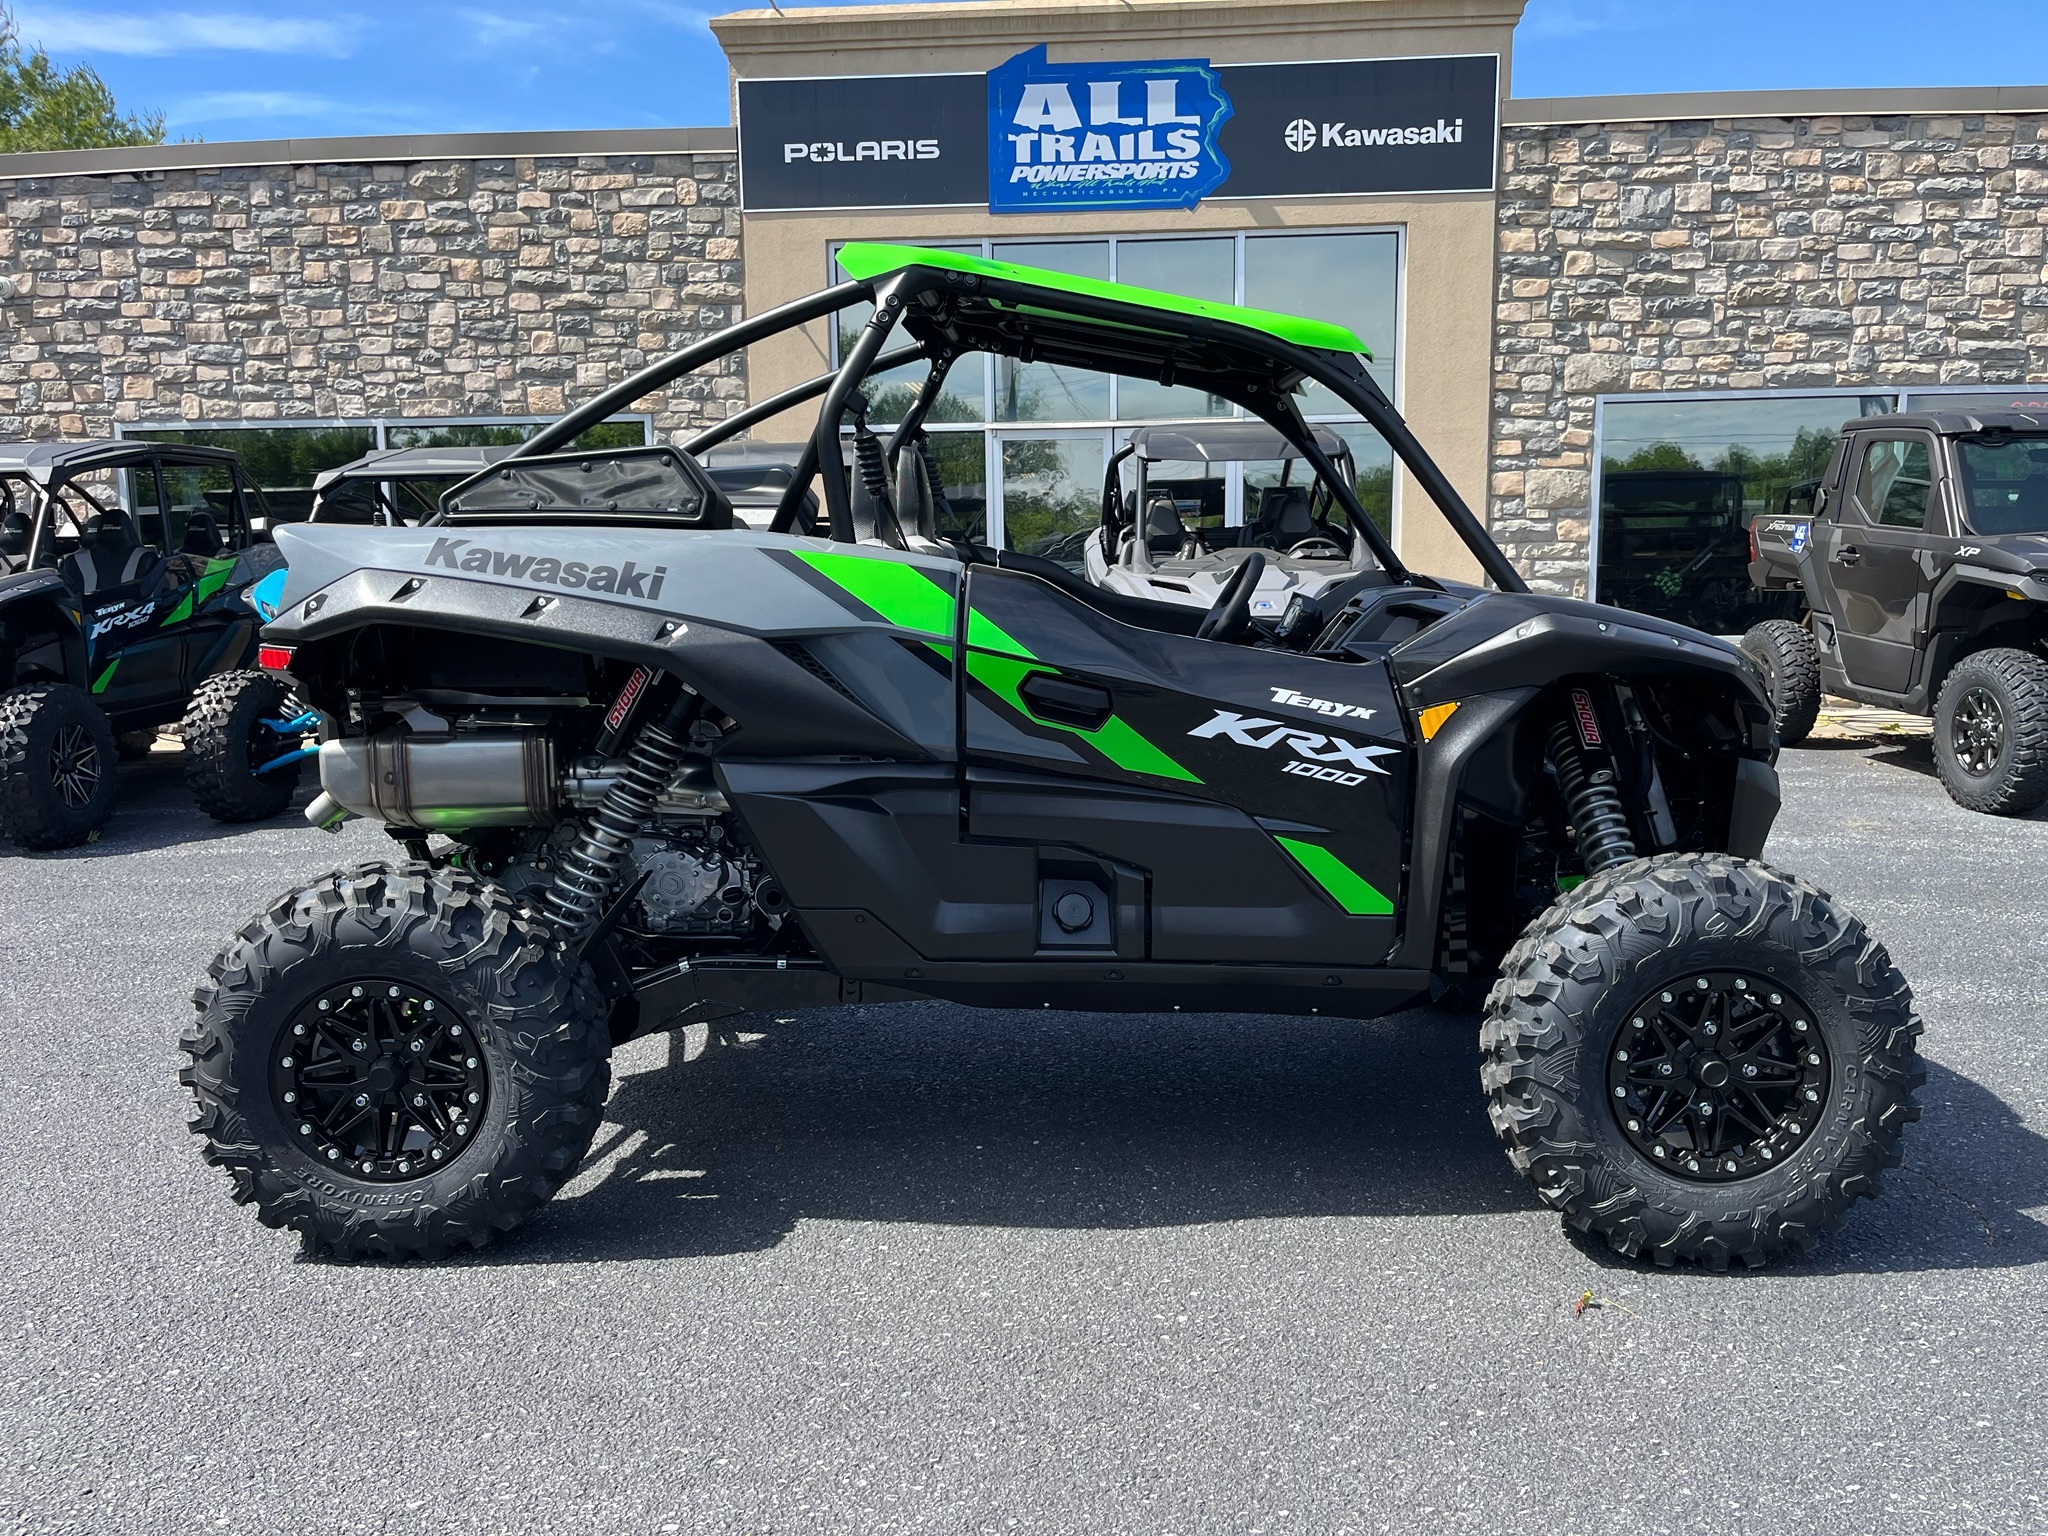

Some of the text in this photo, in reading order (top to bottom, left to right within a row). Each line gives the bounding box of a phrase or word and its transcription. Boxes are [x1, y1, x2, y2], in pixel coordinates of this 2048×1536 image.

[1012, 79, 1201, 132] ALL
[784, 139, 941, 164] POLARIS
[1007, 128, 1201, 163] TRAILS
[1321, 118, 1463, 148] Kawasaki
[1009, 161, 1200, 184] POWERSPORTS
[423, 537, 668, 601] Kawasaki
[1954, 545, 1981, 557] XP
[608, 667, 647, 729] SHOWA
[1571, 693, 1602, 744] SHOWA
[1186, 709, 1402, 776] KRX
[1281, 760, 1368, 787] 1000
[293, 1166, 426, 1207] CARNIVORE
